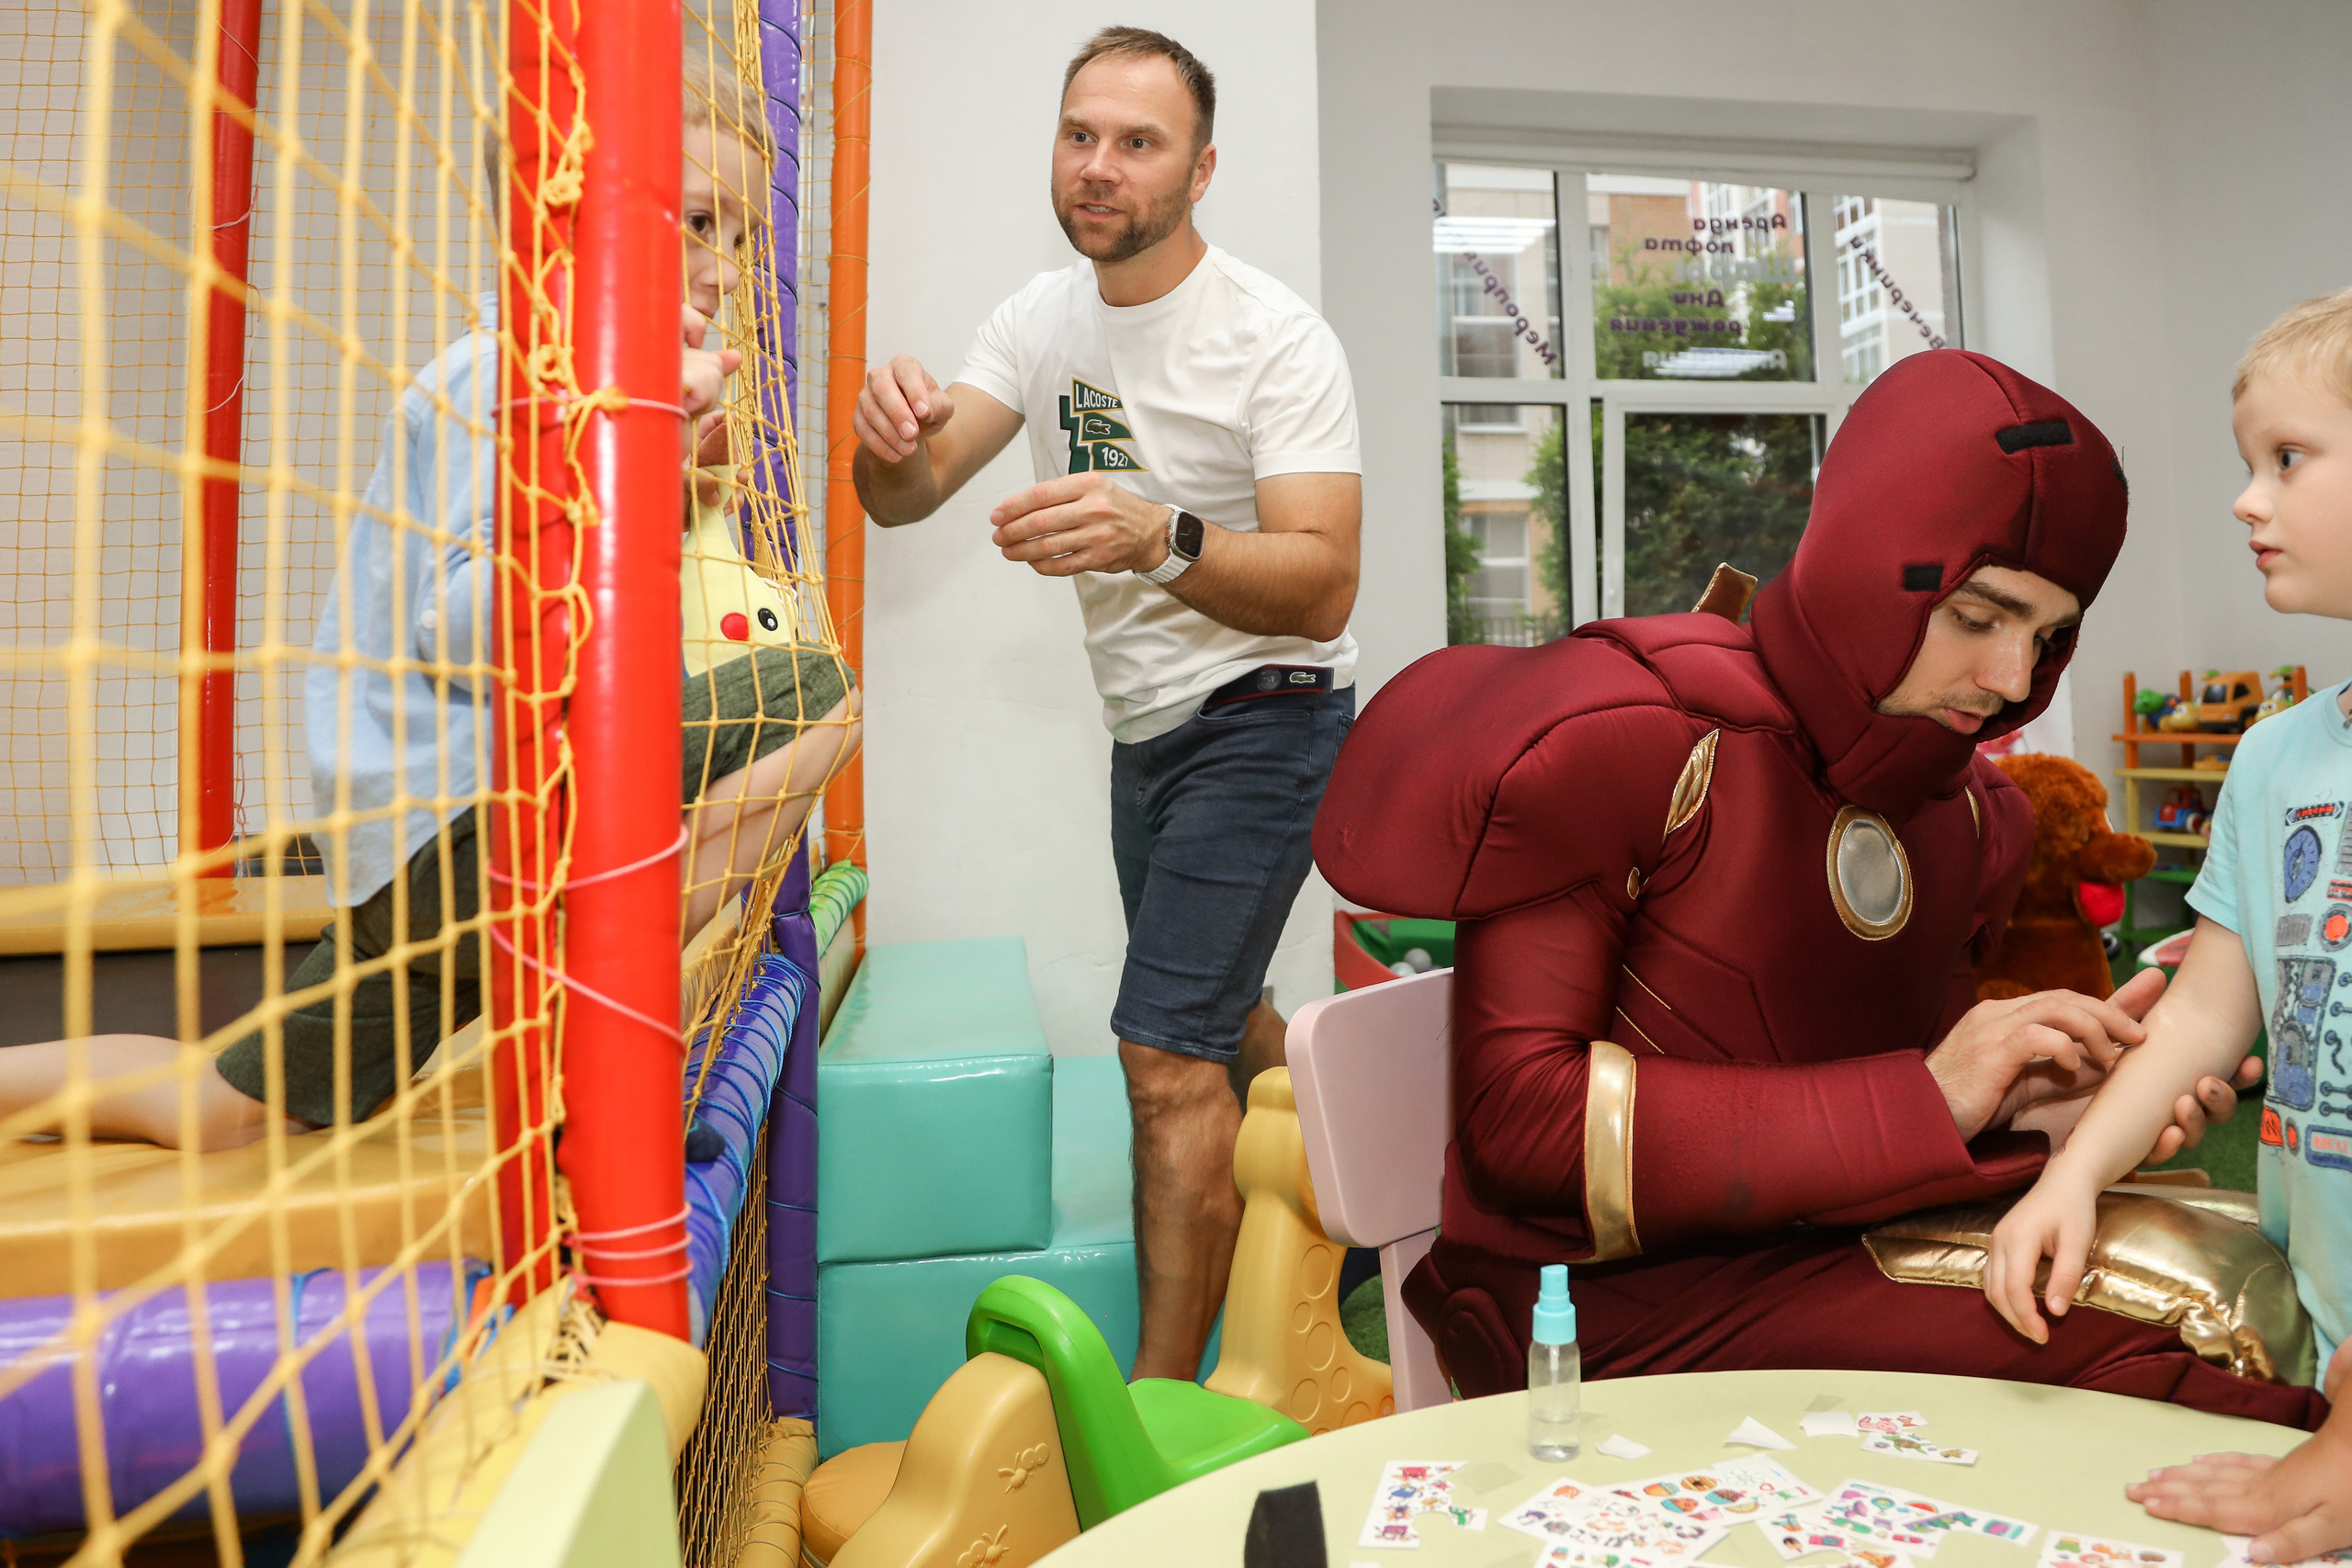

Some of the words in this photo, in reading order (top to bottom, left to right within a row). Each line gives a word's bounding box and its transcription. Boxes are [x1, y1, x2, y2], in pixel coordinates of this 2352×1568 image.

[1075, 383, 1119, 409] LACOSTE
[1102, 446, 1129, 468] 1927
[2312, 1134, 2352, 1155] ROCKE
